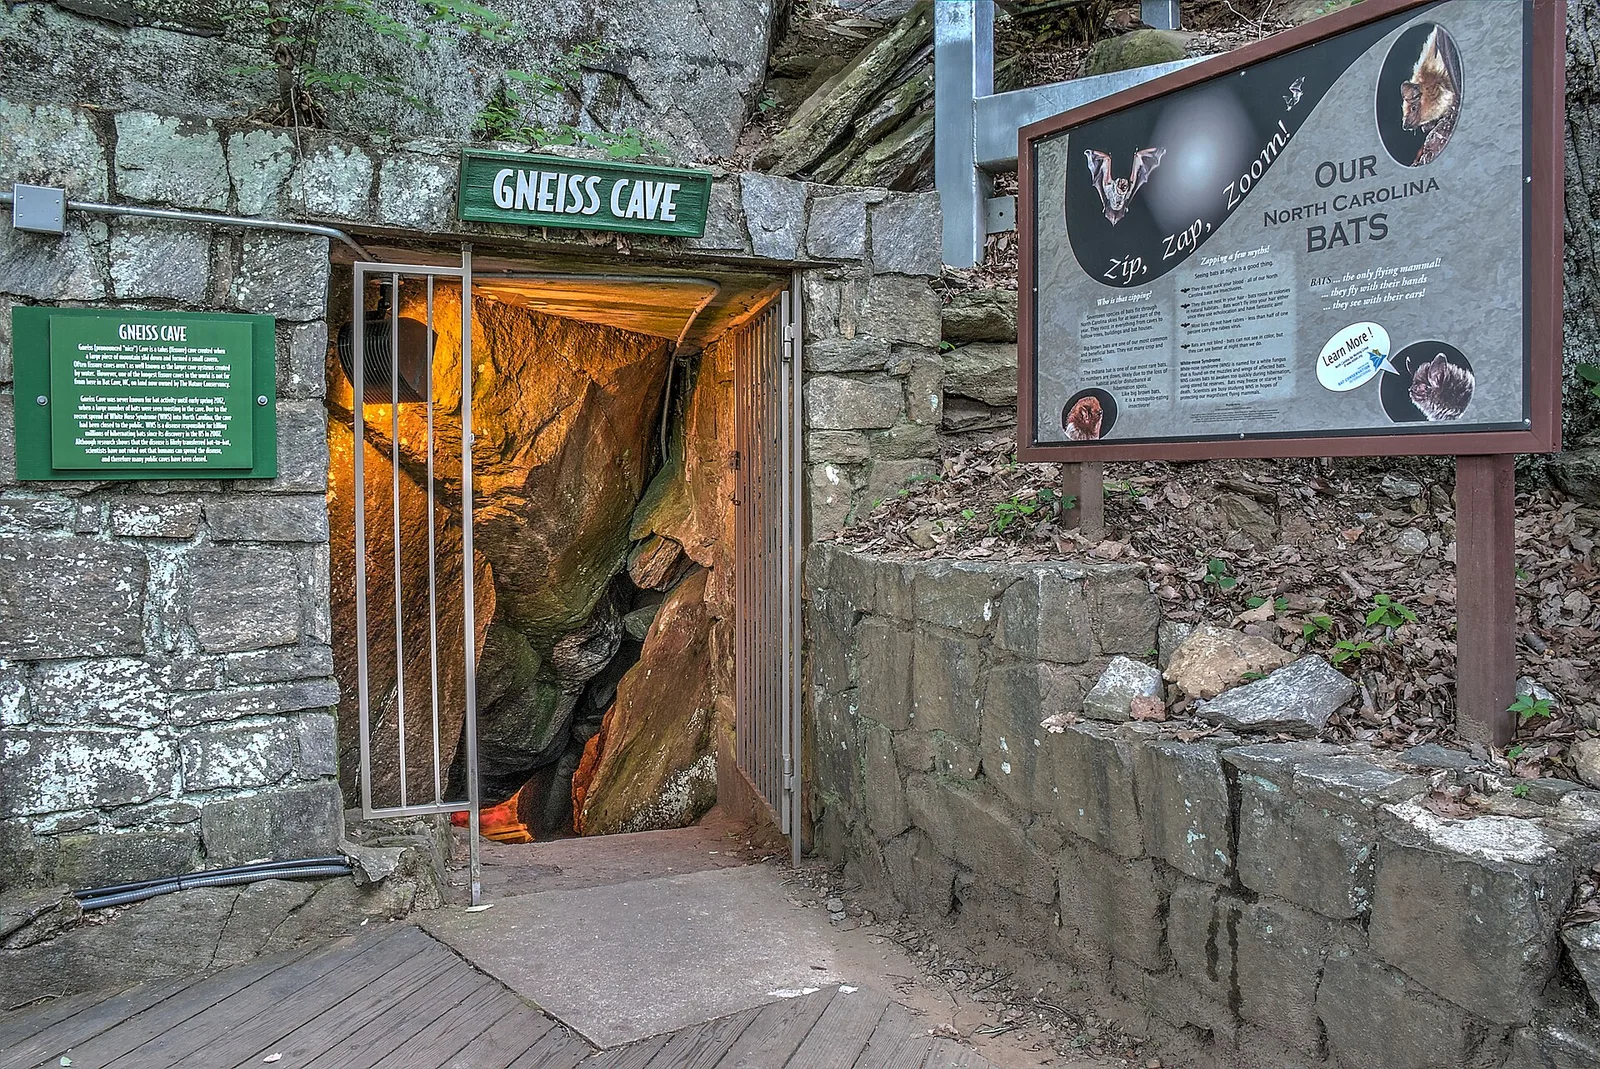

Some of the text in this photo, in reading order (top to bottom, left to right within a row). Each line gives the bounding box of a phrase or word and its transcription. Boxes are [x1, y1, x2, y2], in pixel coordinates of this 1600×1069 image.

[1315, 155, 1377, 188] OUR
[493, 168, 680, 221] GNEISS CAVE
[1264, 177, 1440, 227] NORTH CAROLINA
[1307, 213, 1389, 253] BATS
[1201, 255, 1227, 266] Zapping
[1233, 250, 1246, 261] few
[1248, 245, 1270, 258] myths!
[1310, 277, 1332, 286] BATS
[1343, 273, 1355, 282] the
[1356, 269, 1373, 280] only
[1375, 267, 1398, 279] flying
[1400, 258, 1441, 272] mammal!
[1331, 287, 1347, 297] they
[1348, 285, 1358, 296] fly
[1360, 281, 1378, 292] with
[1380, 279, 1400, 289] their
[1402, 274, 1427, 286] hands
[1333, 300, 1348, 310] they
[1363, 295, 1381, 305] with
[1384, 293, 1404, 302] their
[1405, 288, 1426, 299] ears!
[119, 324, 187, 341] GNEISS CAVE
[1322, 347, 1346, 366] Learn
[1346, 333, 1368, 352] More
